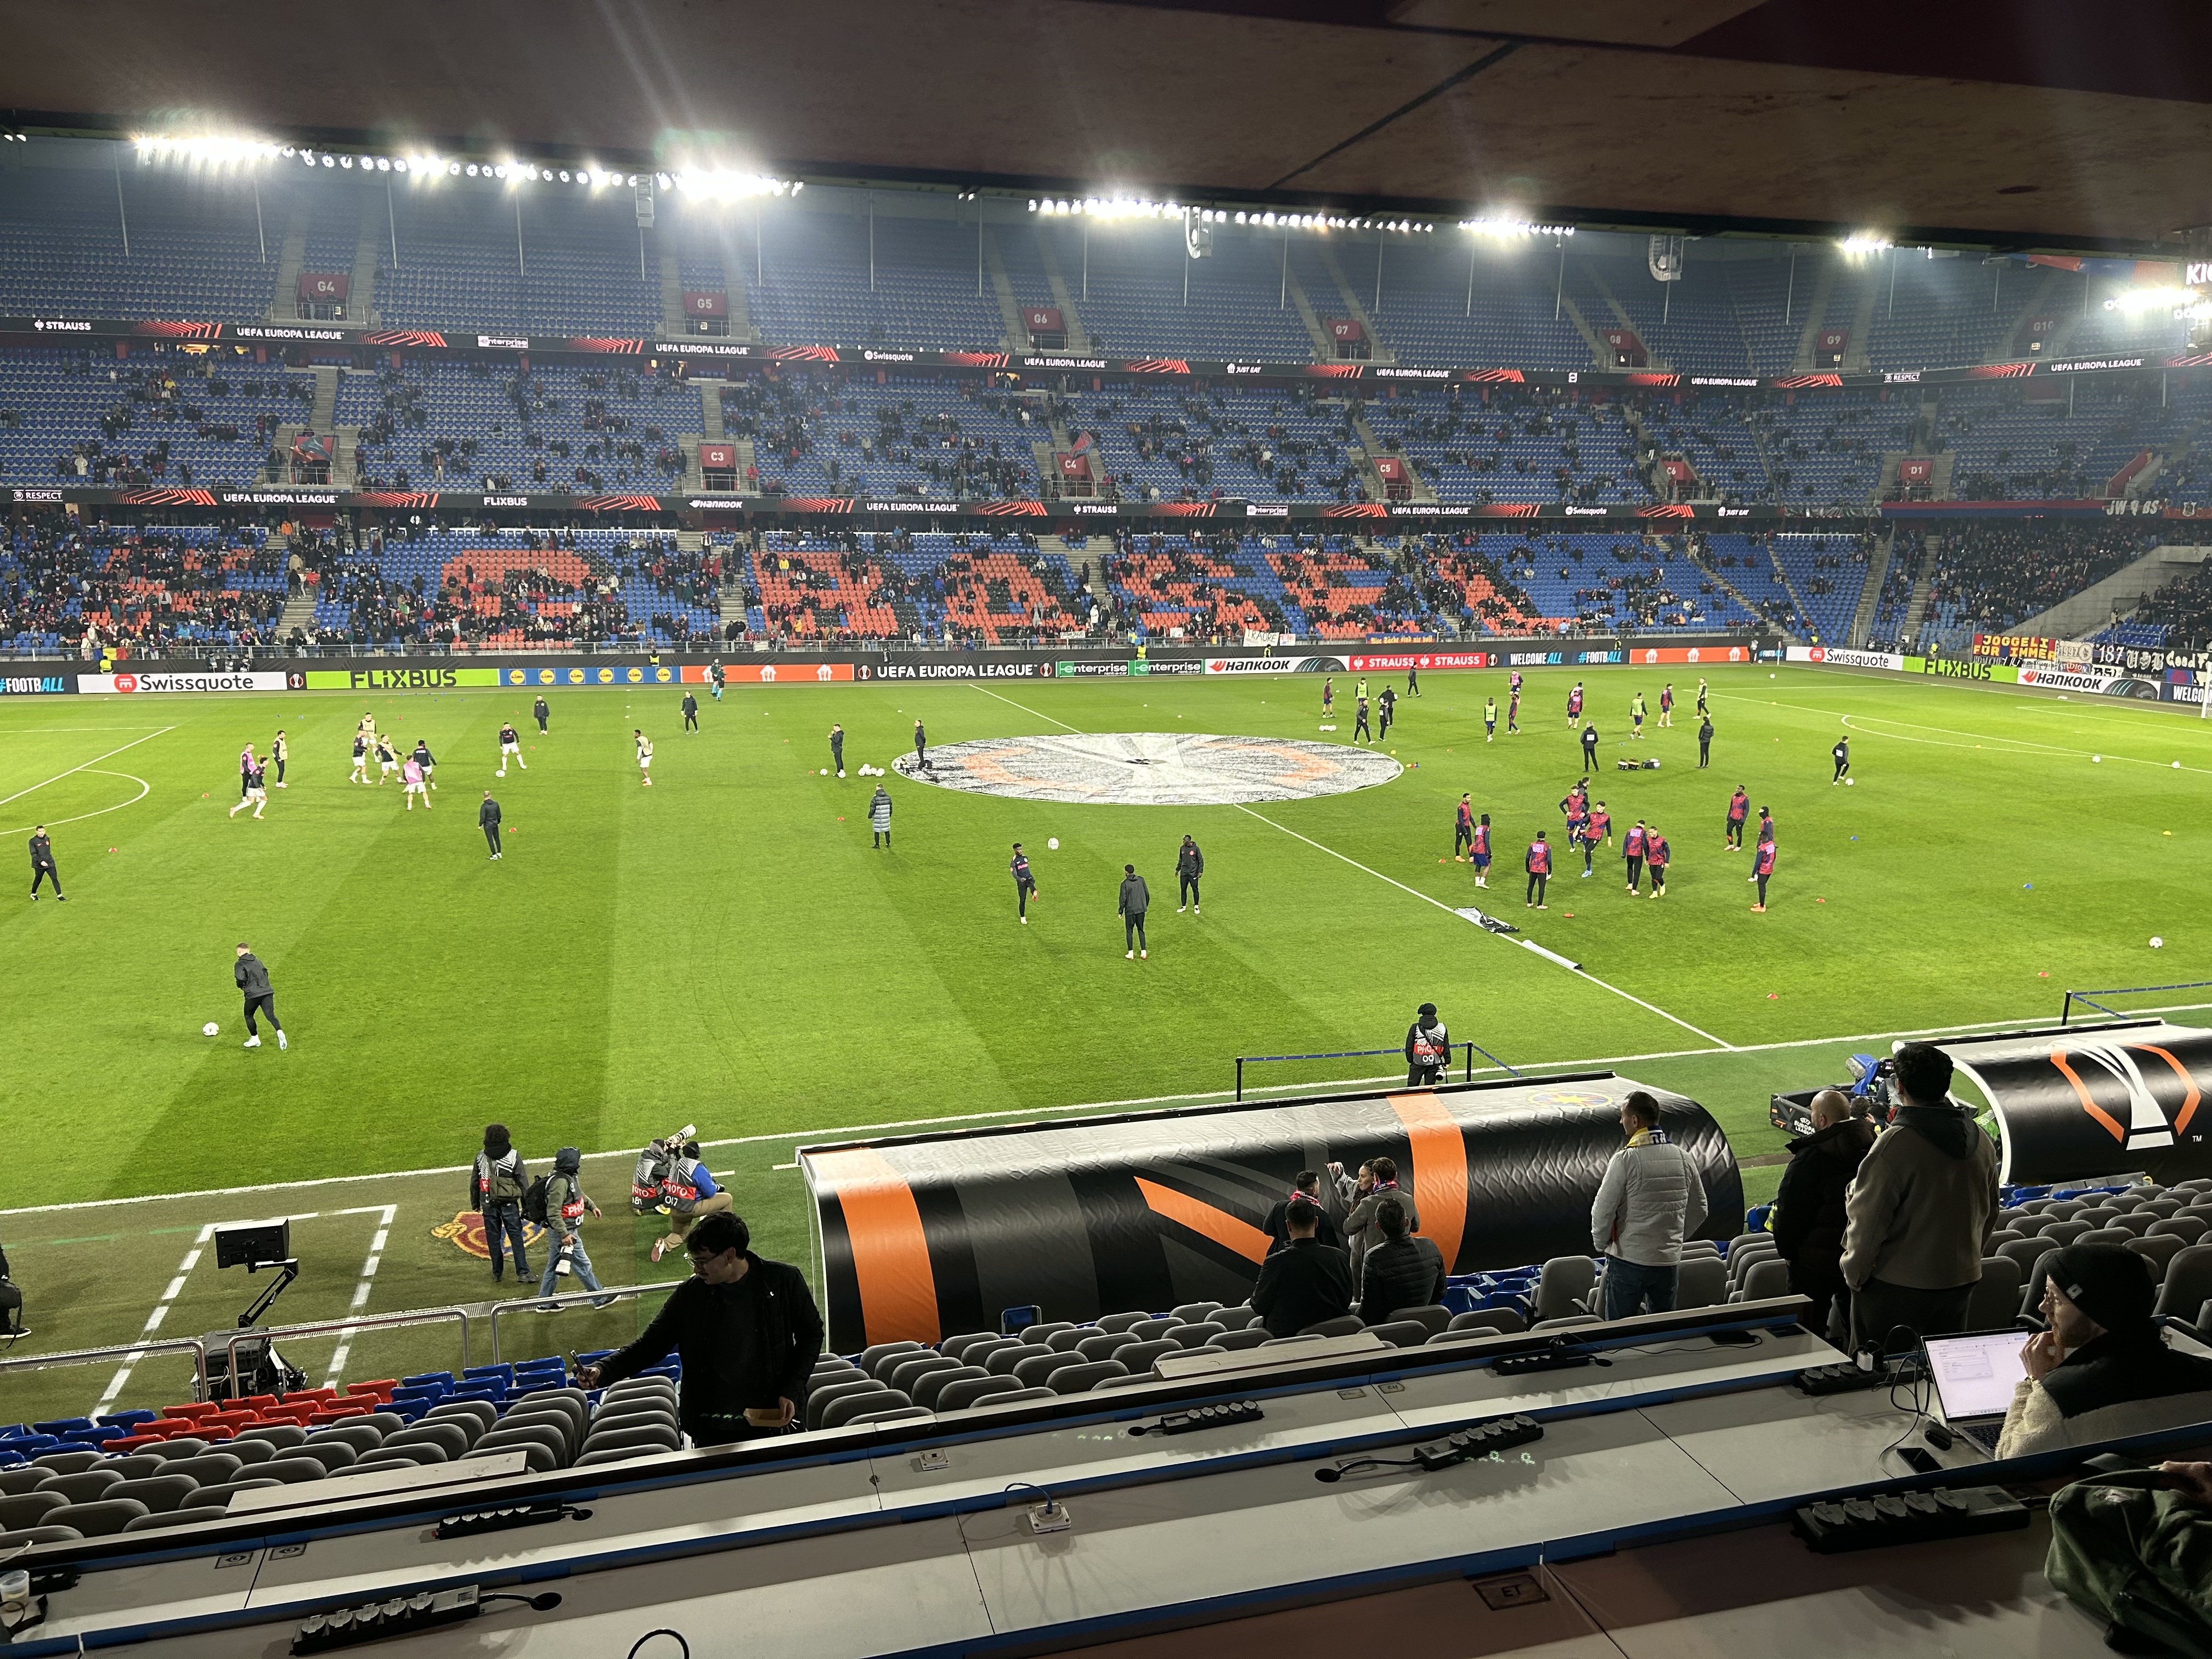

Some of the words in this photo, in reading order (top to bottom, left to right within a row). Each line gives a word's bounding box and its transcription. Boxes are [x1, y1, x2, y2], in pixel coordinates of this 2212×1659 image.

[318, 281, 334, 291] G4
[698, 299, 712, 308] G5
[1034, 314, 1047, 323] G6
[46, 321, 91, 330] STRAUSS
[1336, 325, 1348, 334] G7
[237, 328, 263, 336] UEFA
[265, 329, 303, 338] EUROPA
[305, 331, 341, 339] LEAGUE
[1610, 335, 1621, 344] G8
[1827, 336, 1841, 344] G9
[715, 346, 747, 354] LEAGUE
[873, 352, 913, 362] Swissquote
[2074, 362, 2107, 370] EUROPA
[2108, 359, 2141, 368] LEAGUE
[711, 453, 724, 461] C3
[1065, 460, 1076, 469] C4
[223, 494, 251, 502] UEFA
[253, 494, 294, 503] EUROPA
[296, 495, 336, 503] LEAGUE
[1572, 507, 1607, 516] Swissquote
[1983, 635, 2049, 648] JOGGELI
[1973, 644, 2000, 656] FÜR
[2010, 647, 2055, 661] IMMER
[2059, 645, 2078, 657] 1997
[2098, 645, 2125, 664] 187
[1368, 656, 1414, 668] STRAUSS
[1434, 654, 1480, 665] STRAUSS
[1510, 652, 1546, 665] WELCOME
[1547, 652, 1562, 664] ALL
[1578, 651, 1621, 664] #FOOTBALL
[1827, 648, 1889, 668] Swissquote
[877, 664, 916, 675] UEFA
[919, 663, 976, 675] EUROPA
[979, 662, 1033, 674] LEAGUE
[1064, 663, 1128, 673] enterprise
[1139, 662, 1201, 672] enterprise
[139, 675, 252, 691] Swissquote
[2174, 685, 2212, 703] WELCO
[1794, 1120, 1815, 1133] EUROPA
[2192, 1135, 2202, 1143] TM
[1500, 1584, 1522, 1598] ET
